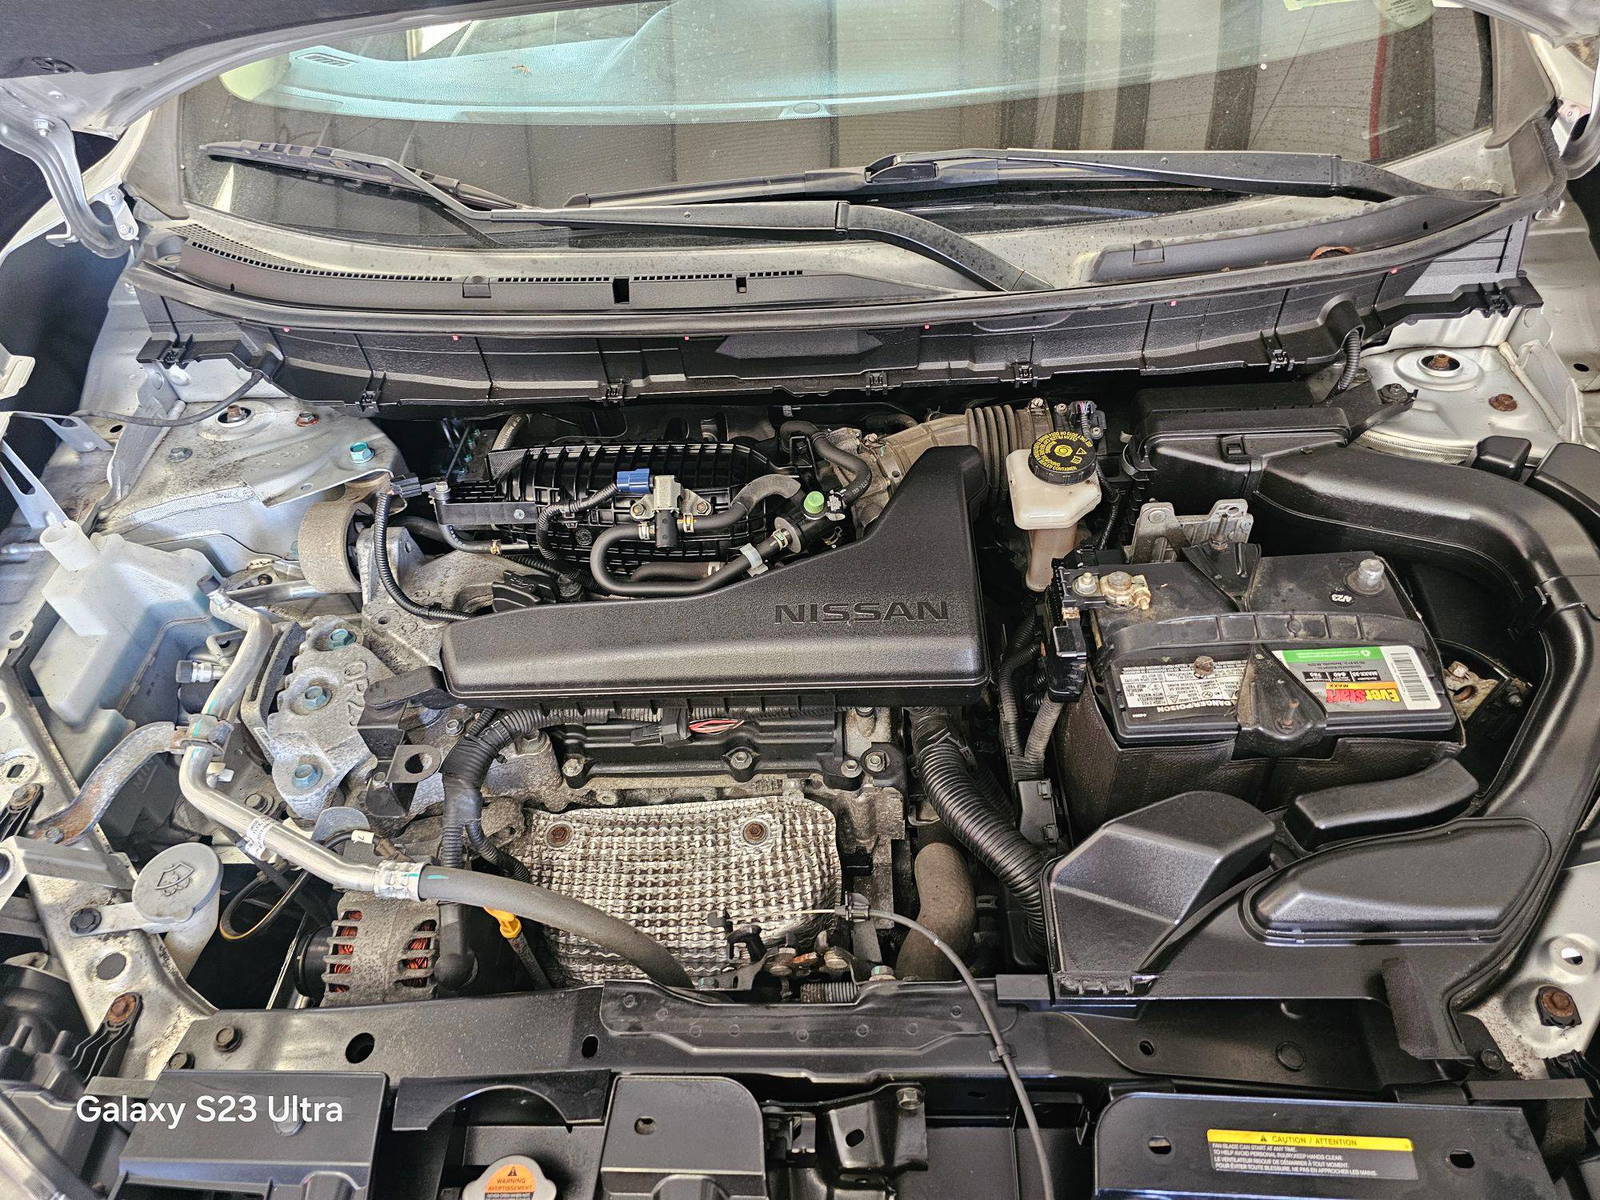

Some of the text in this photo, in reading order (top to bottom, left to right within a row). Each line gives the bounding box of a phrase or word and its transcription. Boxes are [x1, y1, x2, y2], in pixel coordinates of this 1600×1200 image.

[775, 602, 949, 624] NISSAN
[1326, 690, 1400, 704] EverStart
[1272, 1135, 1307, 1144] CAUTION
[1315, 1136, 1357, 1146] ATTENTION
